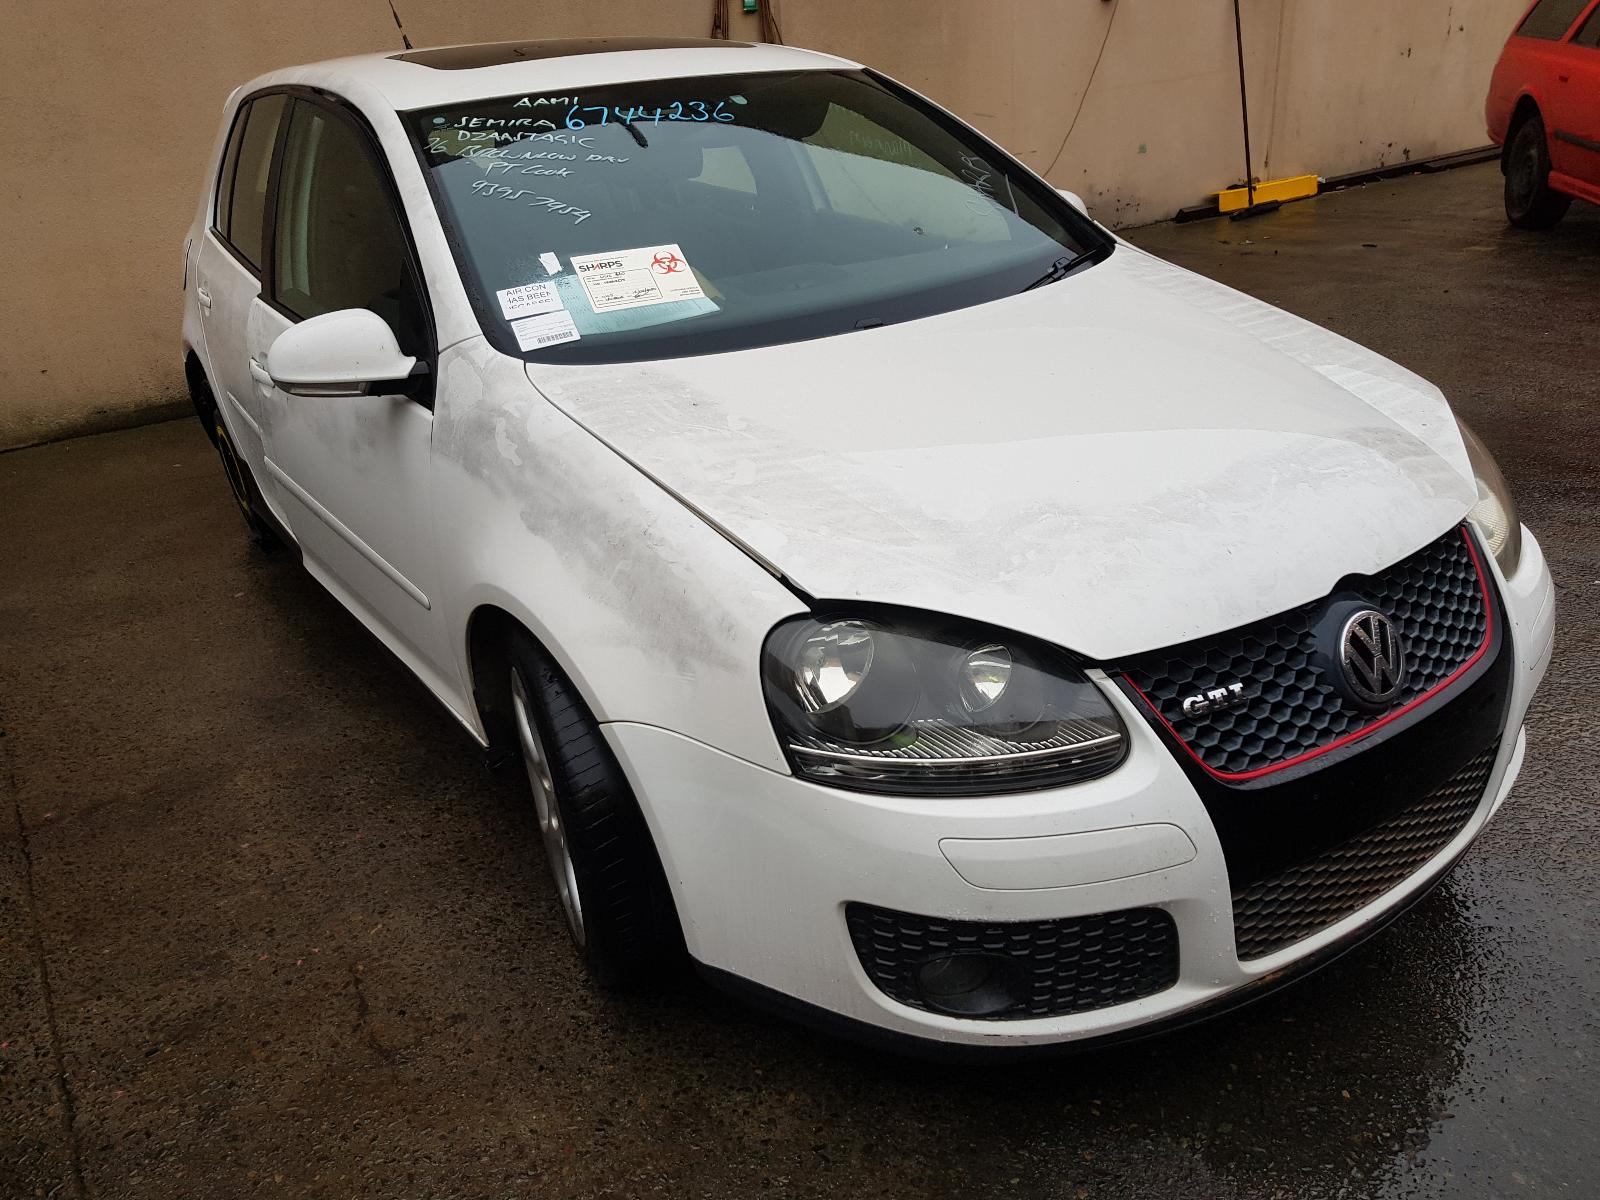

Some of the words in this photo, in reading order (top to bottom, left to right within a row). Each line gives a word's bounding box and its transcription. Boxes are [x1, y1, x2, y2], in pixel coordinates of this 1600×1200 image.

[513, 96, 579, 108] AAMI
[454, 116, 557, 130] SEMIRA
[565, 101, 735, 131] 6744236
[578, 260, 623, 272] SHARPS
[506, 288, 523, 297] AIR
[525, 283, 547, 292] CON
[1183, 683, 1244, 718] GTI
